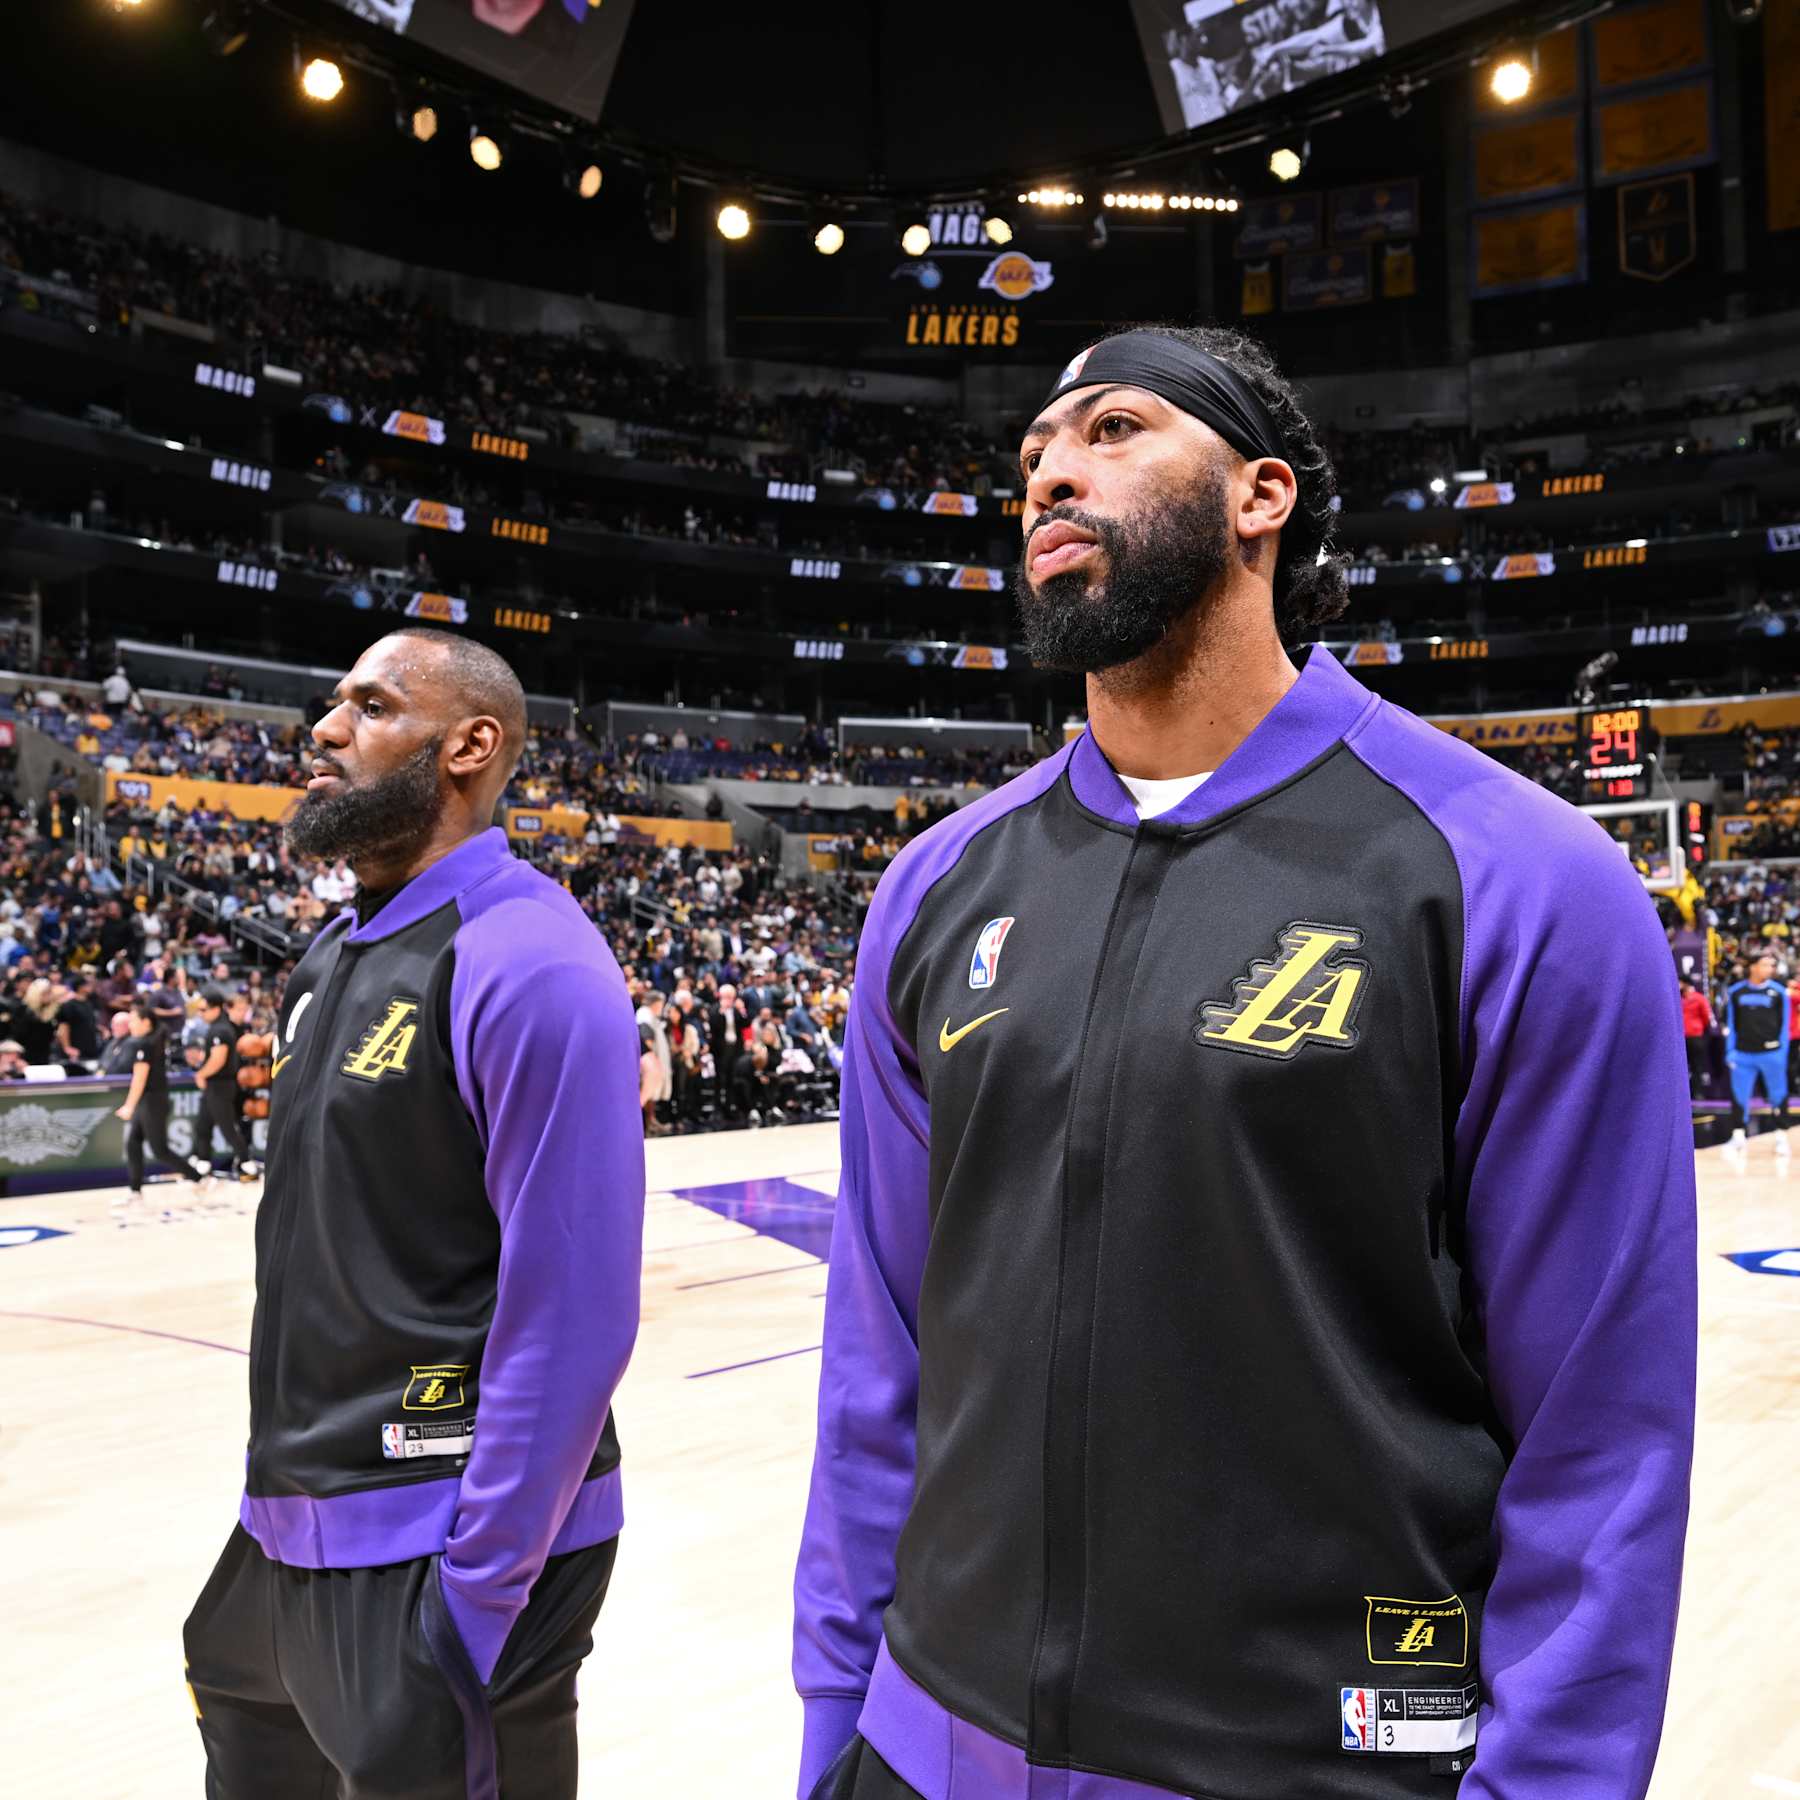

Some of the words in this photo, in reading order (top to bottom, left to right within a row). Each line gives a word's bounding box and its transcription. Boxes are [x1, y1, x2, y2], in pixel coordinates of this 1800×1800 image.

[907, 313, 1019, 345] LAKERS
[195, 363, 255, 398] MAGIC
[471, 431, 528, 461] LAKERS
[210, 458, 272, 491] MAGIC
[1543, 474, 1604, 497] LAKERS
[767, 481, 817, 502] MAGIC
[491, 517, 549, 545] LAKERS
[791, 559, 841, 579] MAGIC
[1584, 546, 1647, 569] LAKERS
[217, 561, 278, 591] MAGIC
[494, 608, 551, 634] LAKERS
[1631, 623, 1688, 646] MAGIC
[794, 641, 844, 660] MAGIC
[1430, 640, 1488, 660] LAKERS
[1590, 730, 1636, 765] 24
[1203, 931, 1361, 1052] LA
[344, 1001, 417, 1079] LA
[408, 1429, 419, 1437] XL
[1375, 1606, 1411, 1616] LEAVE
[1421, 1606, 1463, 1617] LEGACY
[1395, 1618, 1434, 1653] LA
[1383, 1699, 1401, 1713] XL
[1408, 1696, 1462, 1705] ENGINEERED
[1383, 1725, 1395, 1746] 3
